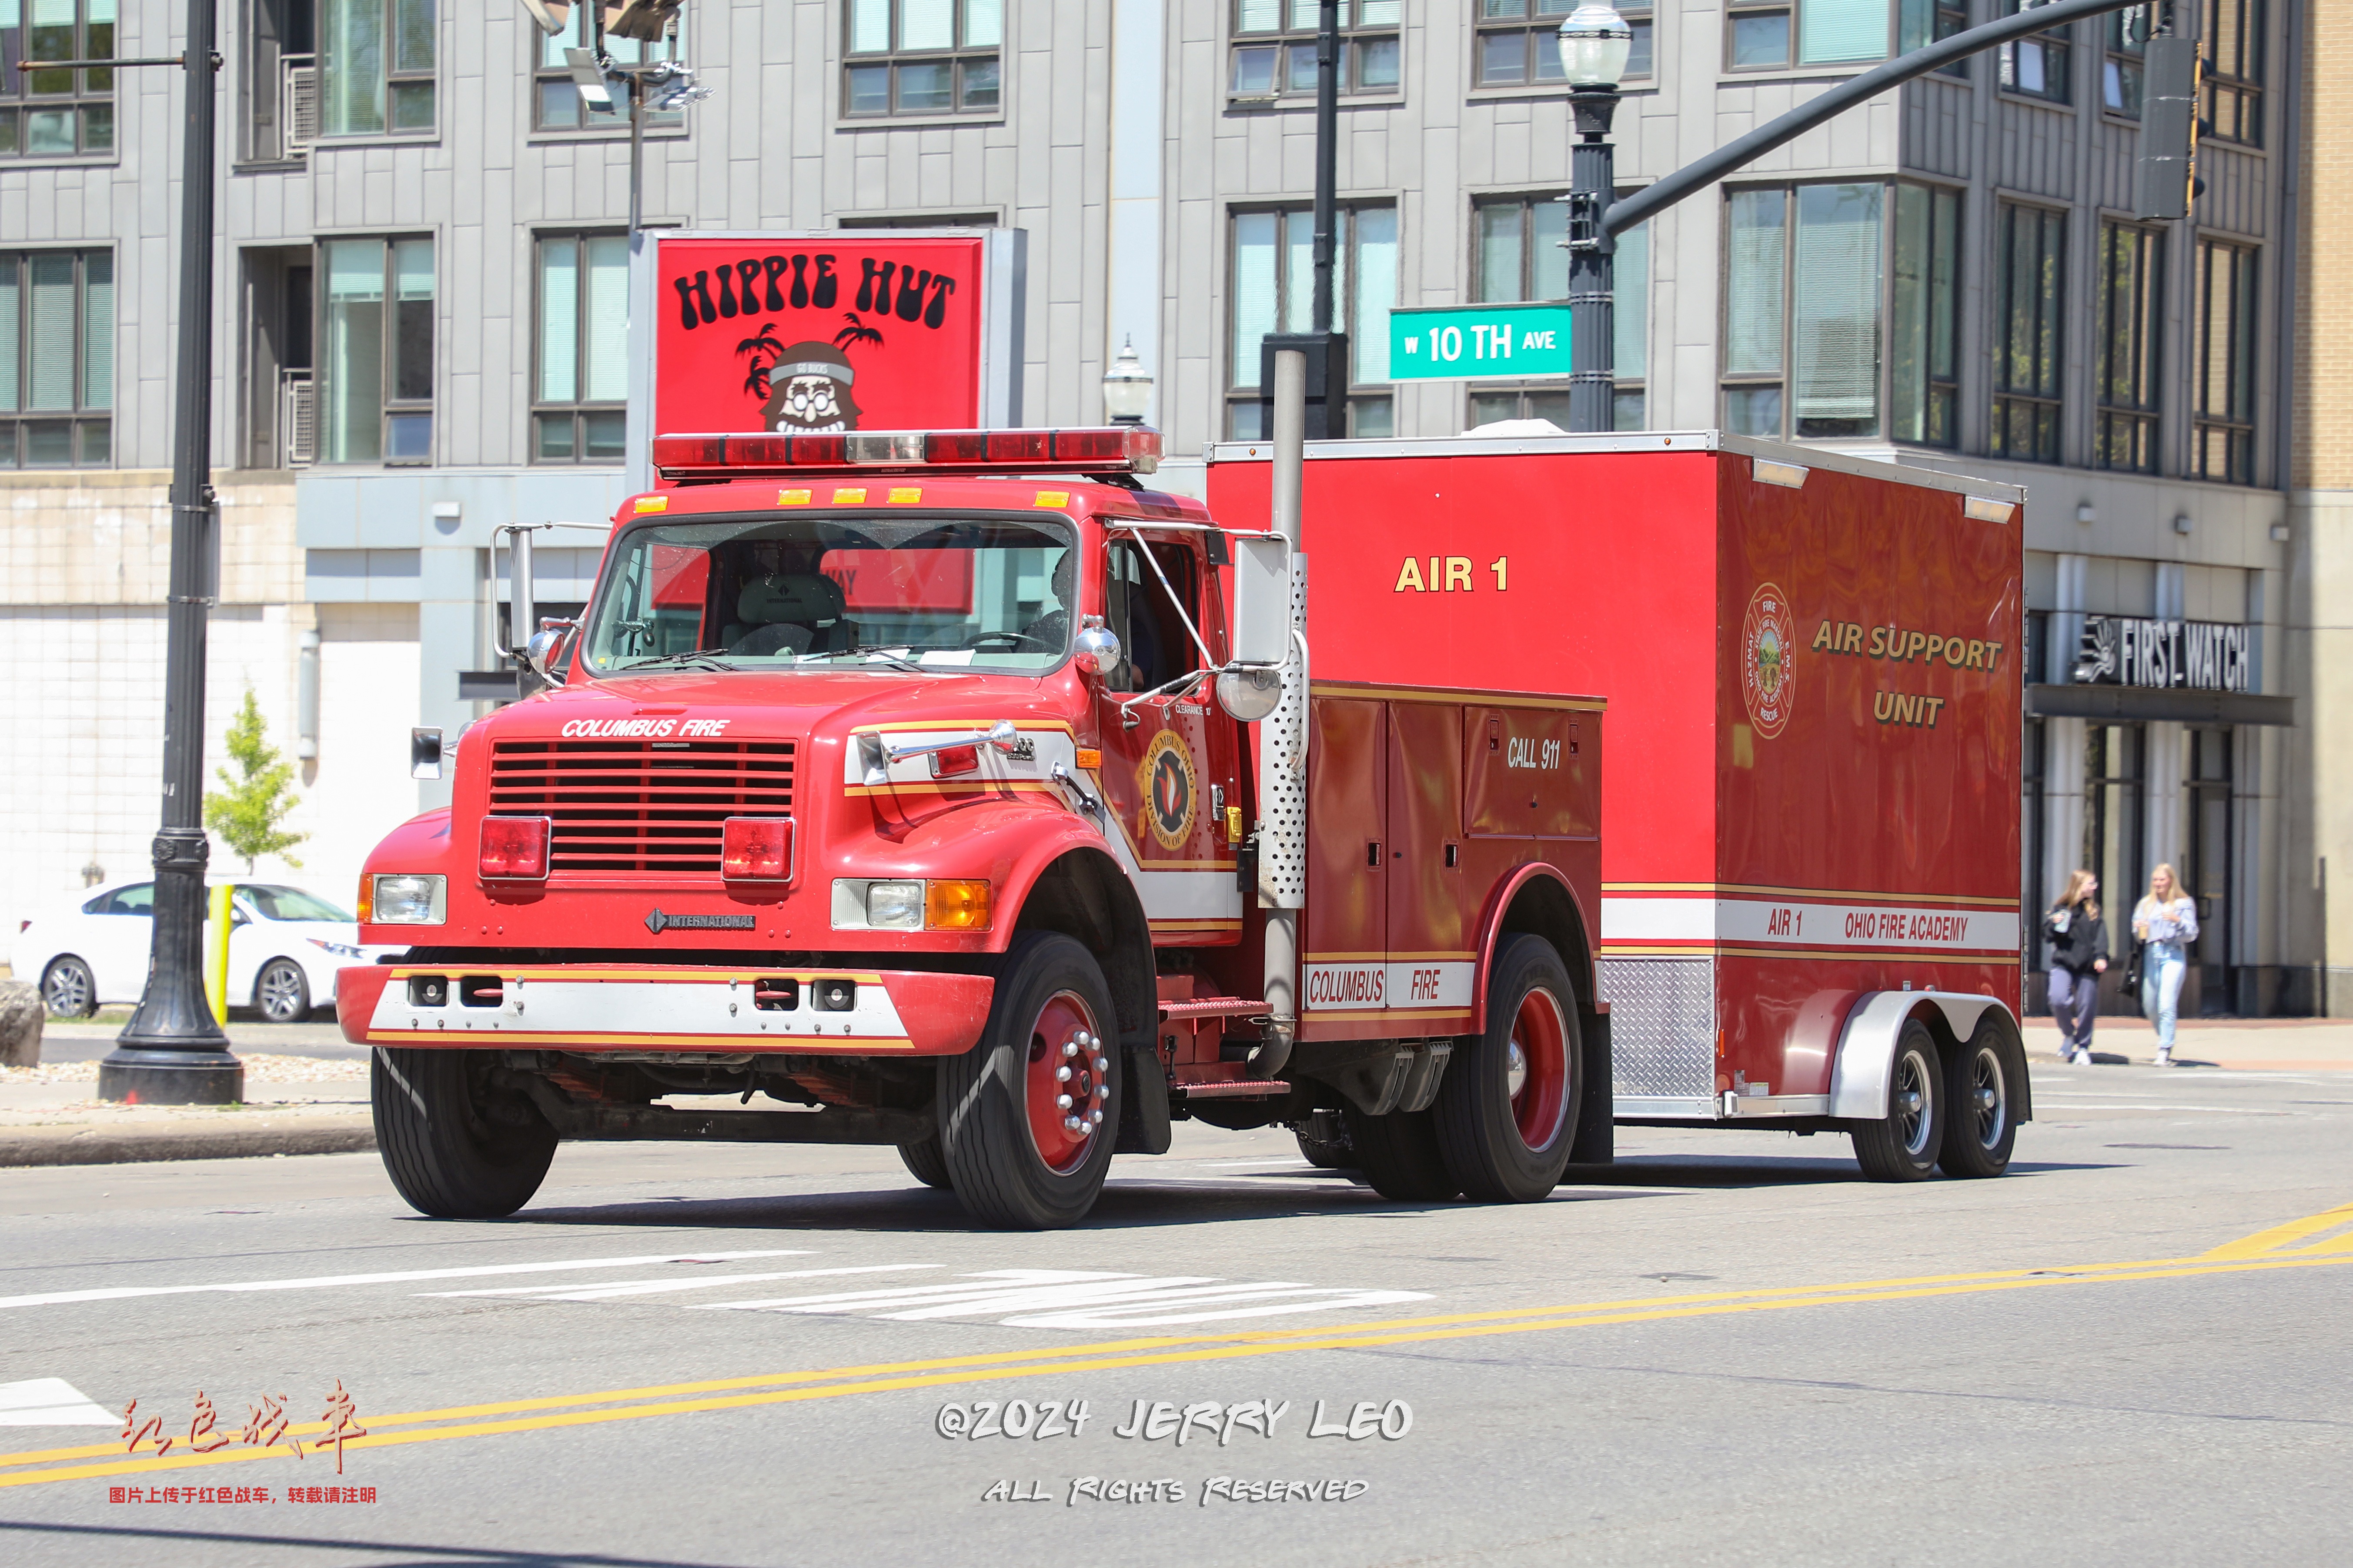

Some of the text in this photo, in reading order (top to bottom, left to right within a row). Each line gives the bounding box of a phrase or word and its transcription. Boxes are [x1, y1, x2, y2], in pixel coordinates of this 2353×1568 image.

[674, 254, 956, 330] HIPPIE HUT
[1404, 324, 1557, 362] W 10 TH AVE
[1393, 556, 1508, 593] AIR 1
[1762, 600, 1776, 614] FIRE
[1755, 626, 1763, 650] STATE
[1770, 619, 1783, 652] MARSHAL
[1812, 620, 2002, 671] AIR SUPPORT
[2121, 618, 2249, 692] FIRST WATCH
[1769, 672, 1784, 704] ACADEMY
[1176, 704, 1203, 716] CLEARANCE
[1760, 706, 1778, 722] RESCUE
[1874, 691, 1944, 726] UNIT
[561, 719, 731, 737] COLUMBUS FIRE
[1146, 734, 1195, 789] COLUMBUS OHIO
[1508, 737, 1561, 770] CALL 911
[1146, 795, 1170, 847] DIVISION
[1172, 833, 1181, 847] OF
[668, 915, 755, 928] INTERNATIONAL
[1767, 908, 1803, 937] AIR 1
[1845, 912, 1969, 942] OHIO FIRE ACADEMY
[1310, 969, 1441, 1004] COLUMBUS FIRE
